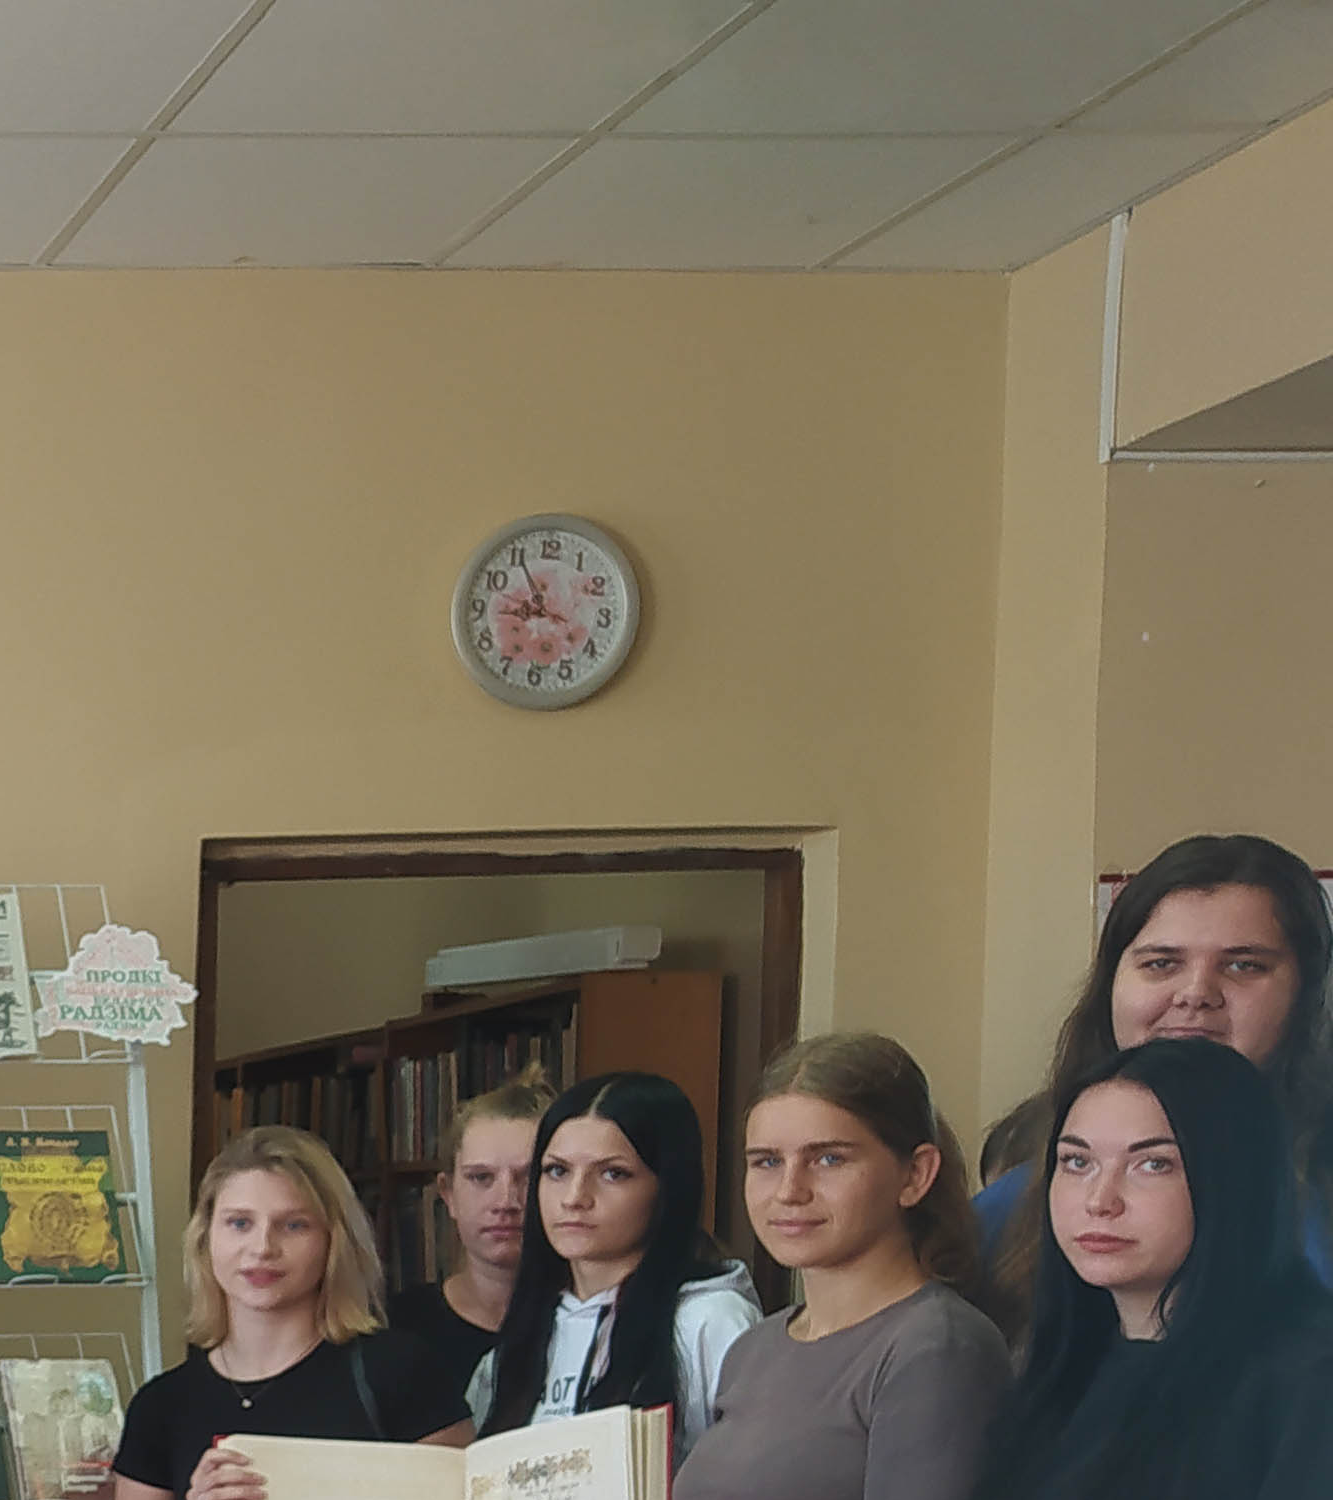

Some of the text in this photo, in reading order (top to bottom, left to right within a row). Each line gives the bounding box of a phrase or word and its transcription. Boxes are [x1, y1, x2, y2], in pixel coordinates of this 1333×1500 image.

[540, 540, 561, 560] 12
[575, 552, 583, 572] 1
[487, 570, 508, 591] 10
[590, 575, 605, 596] 2
[471, 599, 486, 622] 9
[596, 608, 611, 628] 3
[477, 628, 493, 651] 8
[583, 637, 598, 657] 4
[499, 656, 513, 676] 7
[527, 660, 542, 687] 6
[557, 659, 573, 680] 5
[86, 969, 162, 984] ПРОДКІ
[59, 1004, 163, 1021] РАДЗІМА
